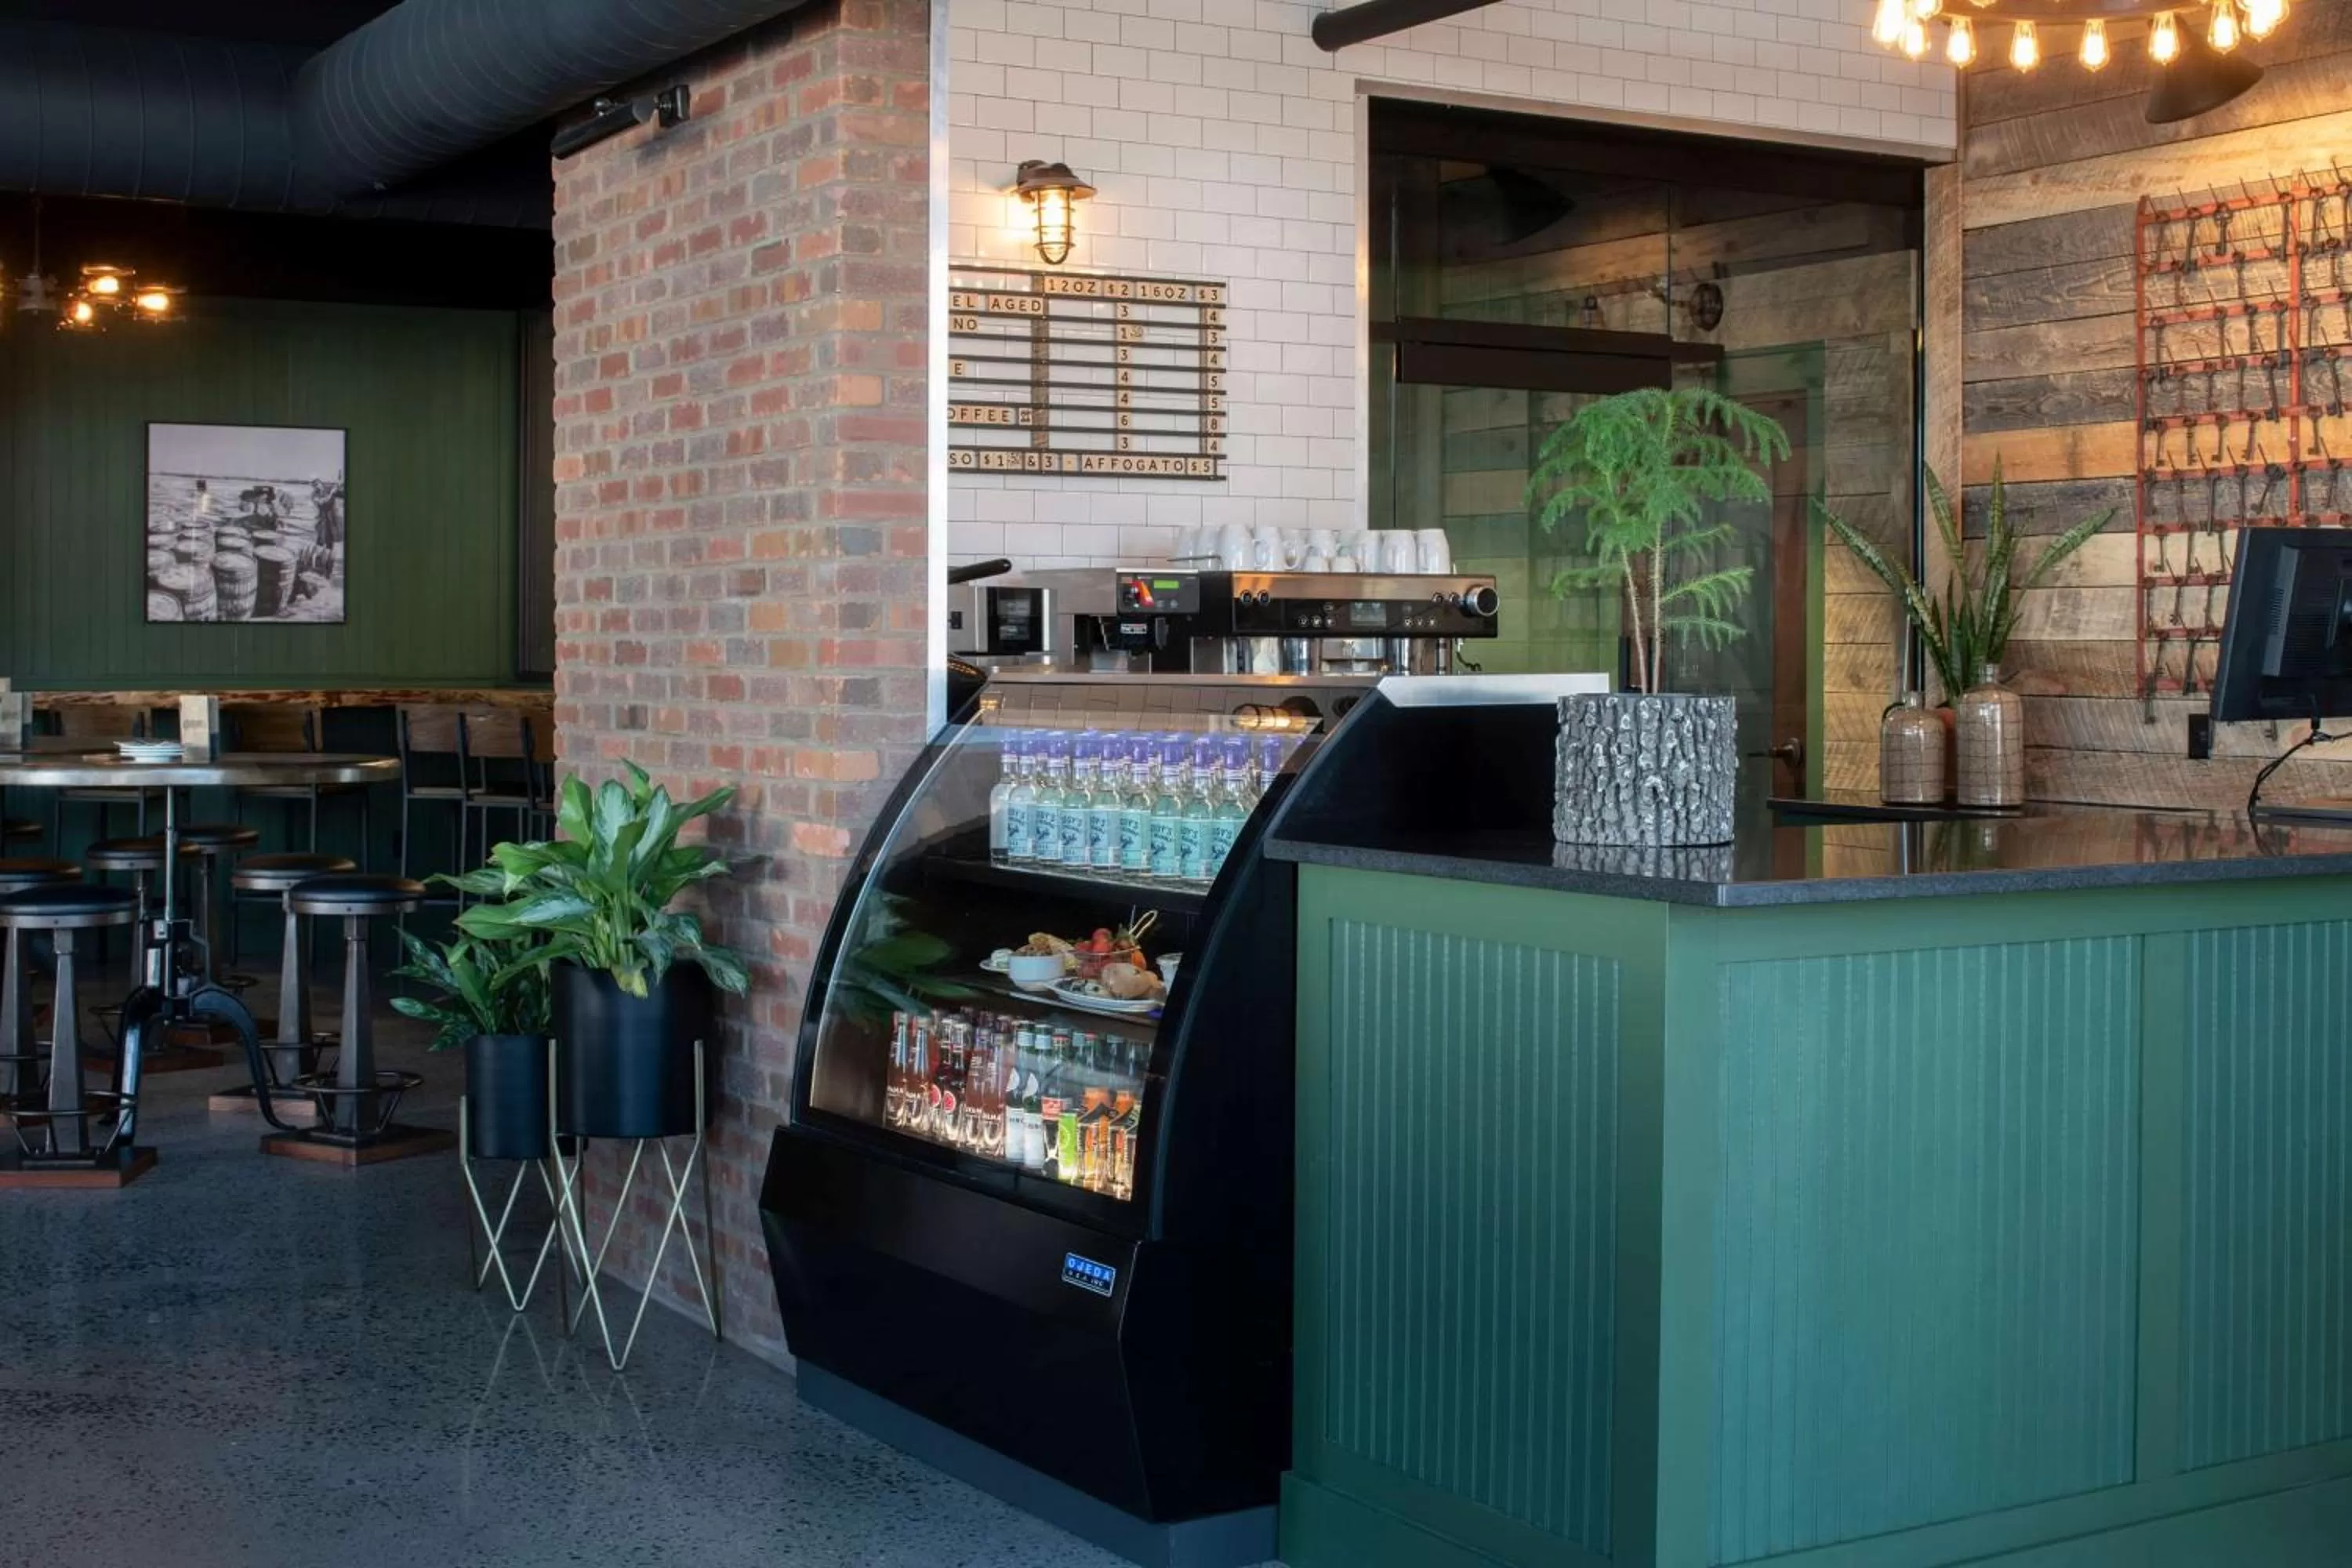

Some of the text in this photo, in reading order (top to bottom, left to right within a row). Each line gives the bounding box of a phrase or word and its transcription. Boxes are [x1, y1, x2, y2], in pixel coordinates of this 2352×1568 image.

[1048, 278, 1096, 294] 12OZ
[1141, 285, 1186, 299] 16OZ
[953, 295, 1217, 322] EL AGED 3 4
[953, 317, 978, 330] NO
[1210, 331, 1218, 343] 3
[1120, 348, 1218, 365] 3 4
[954, 362, 1218, 388] E 4 5
[1120, 392, 1218, 409] 4 5
[1120, 414, 1128, 427] 6
[1210, 417, 1218, 430] 8
[1121, 436, 1218, 452] 3 4
[949, 452, 972, 465] SO
[1027, 455, 1036, 467] &
[1044, 455, 1053, 469] 3
[1083, 456, 1184, 472] AFFOGATO
